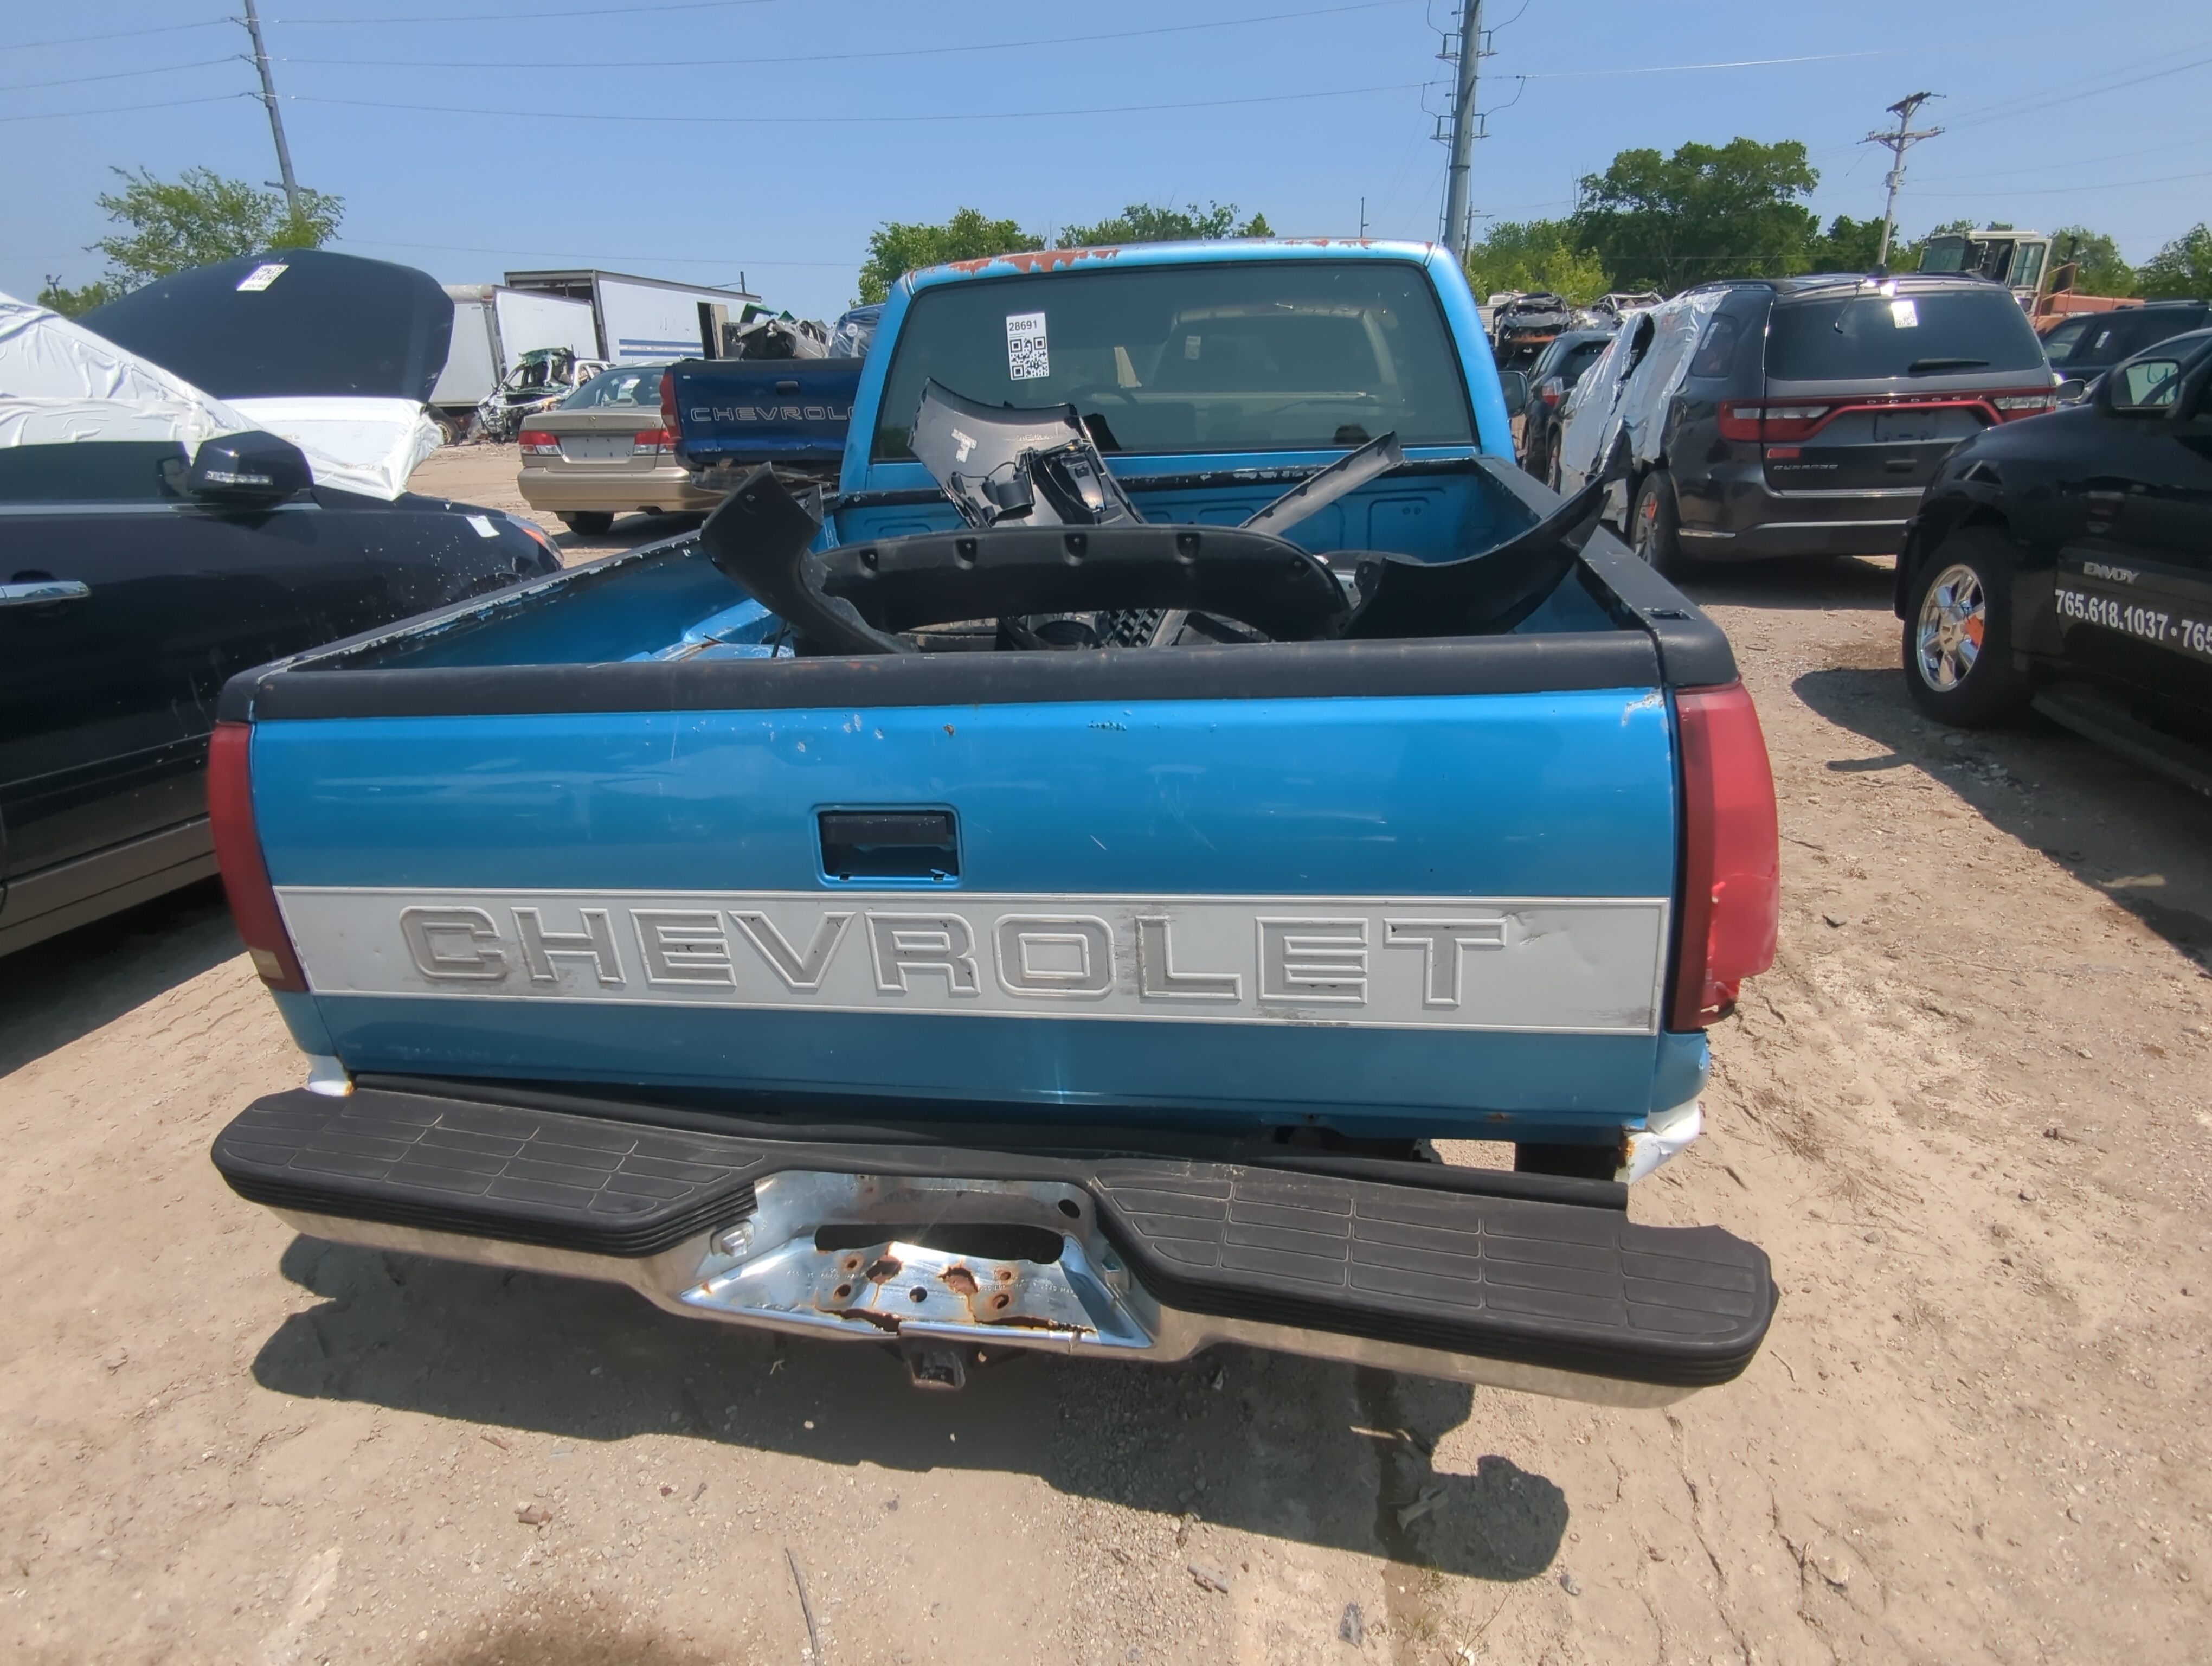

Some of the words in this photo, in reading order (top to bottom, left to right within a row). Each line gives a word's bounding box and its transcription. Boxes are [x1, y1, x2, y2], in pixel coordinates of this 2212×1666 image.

[1009, 320, 1037, 331] 28691
[690, 406, 855, 421] CHEVROL
[2083, 561, 2140, 585] ENVOY
[2055, 589, 2168, 641] 765.618.1037
[399, 905, 1507, 1007] CHEVROLET
